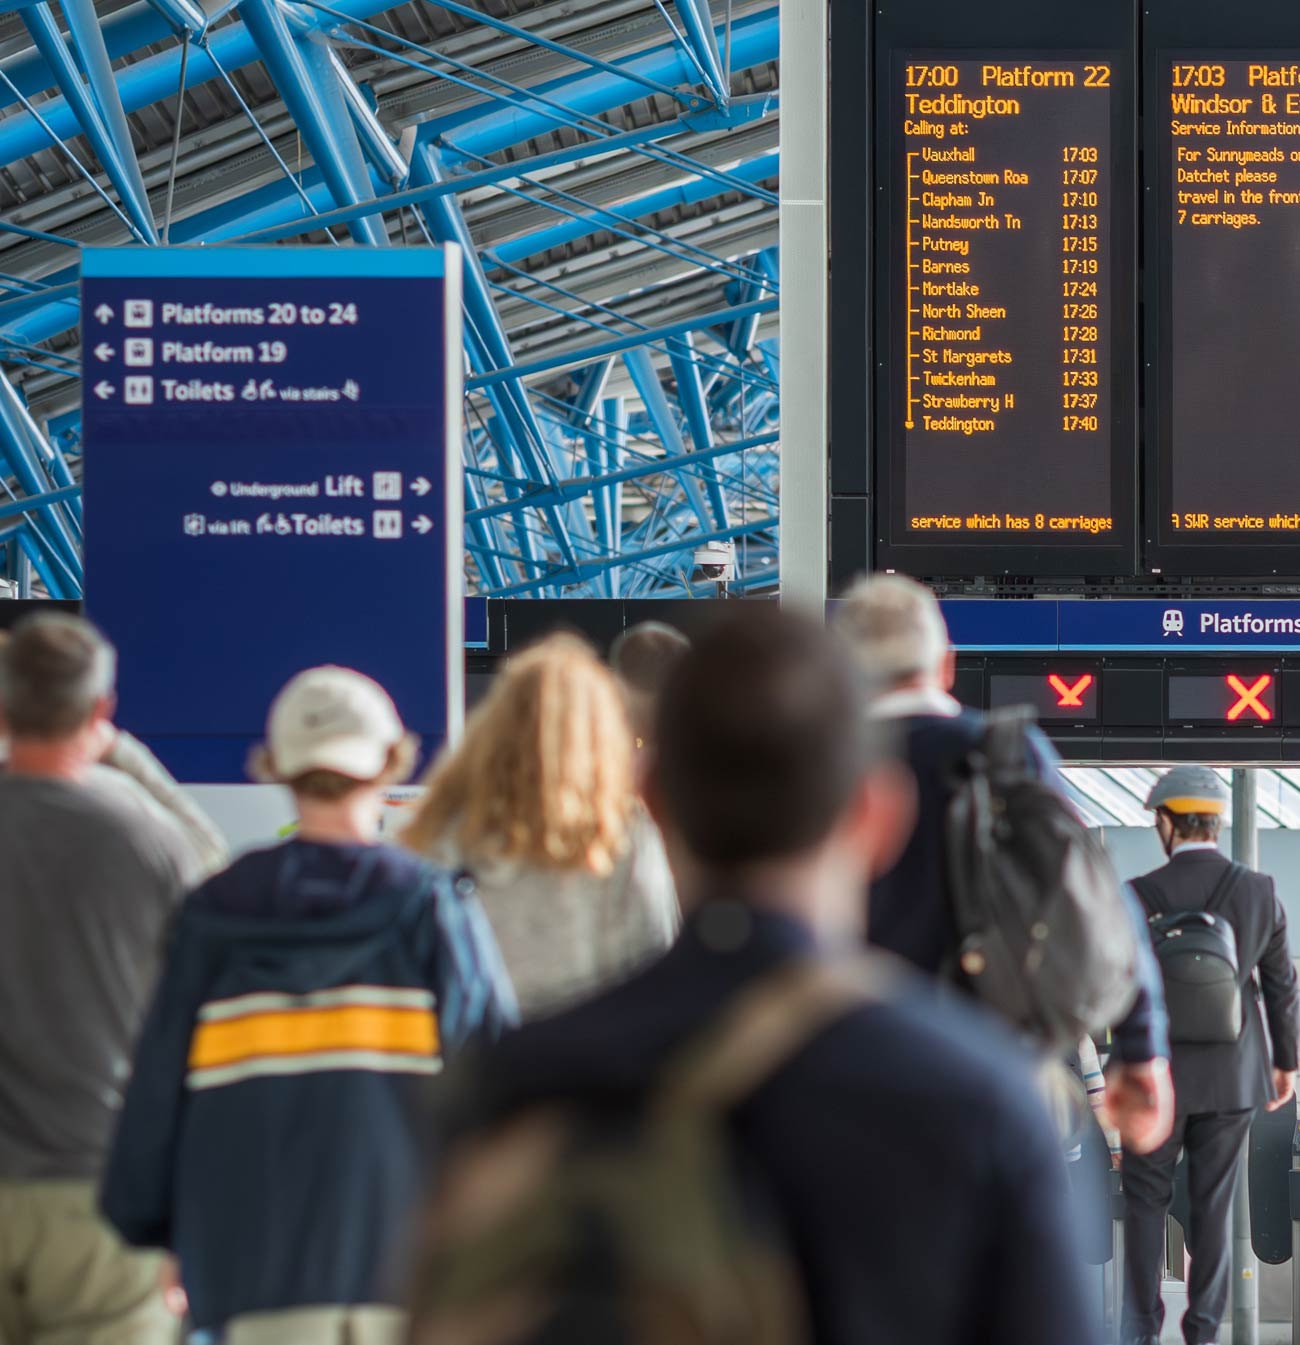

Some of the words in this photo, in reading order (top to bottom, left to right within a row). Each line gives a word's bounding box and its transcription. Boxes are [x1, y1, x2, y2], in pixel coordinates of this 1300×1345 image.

[906, 66, 958, 86] 17:00
[983, 66, 1073, 86] Platform
[1084, 66, 1110, 87] 22
[1173, 66, 1225, 86] 17:03
[905, 94, 1019, 118] Teddington
[1172, 94, 1252, 114] Windsor
[1262, 94, 1276, 113] &
[905, 120, 944, 138] Calling
[950, 122, 968, 135] at:
[1172, 121, 1220, 135] Service
[923, 147, 974, 161] Vauxhall
[1063, 147, 1097, 162] 17:03
[1178, 147, 1201, 161] For
[1207, 147, 1284, 165] Sunnymeads
[923, 170, 999, 185] Queenstown
[1004, 170, 1028, 184] Roa
[1064, 170, 1097, 184] 17:07
[1178, 168, 1229, 182] Datchet
[1236, 168, 1277, 186] please
[923, 192, 972, 209] Clapham
[978, 192, 994, 206] Jn
[1063, 192, 1097, 207] 17:10
[923, 214, 999, 229] Wandsworth
[1005, 214, 1020, 228] Tn
[1063, 215, 1097, 229] 17:13
[1178, 210, 1186, 224] 7
[1192, 212, 1260, 228] carriages.
[923, 237, 969, 254] Putney
[1063, 237, 1097, 251] 17:15
[162, 303, 265, 324] Platforms
[268, 303, 297, 324] 20
[300, 306, 325, 324] to
[329, 303, 357, 325] 24
[162, 342, 254, 362] Platform
[259, 342, 287, 362] 19
[162, 380, 234, 401] Toilets
[280, 388, 301, 400] via
[302, 388, 340, 401] stairs
[923, 394, 999, 412] Strawberry
[1005, 394, 1013, 408] H
[1064, 394, 1097, 408] 17:37
[923, 416, 994, 434] Teddington
[1064, 416, 1097, 430] 17:40
[230, 483, 319, 499] Underground
[325, 475, 363, 496] Lift
[208, 521, 228, 534] via
[231, 520, 250, 534] lift
[290, 514, 364, 535] Toilets
[1185, 514, 1208, 528] SWR
[1214, 515, 1264, 528] service
